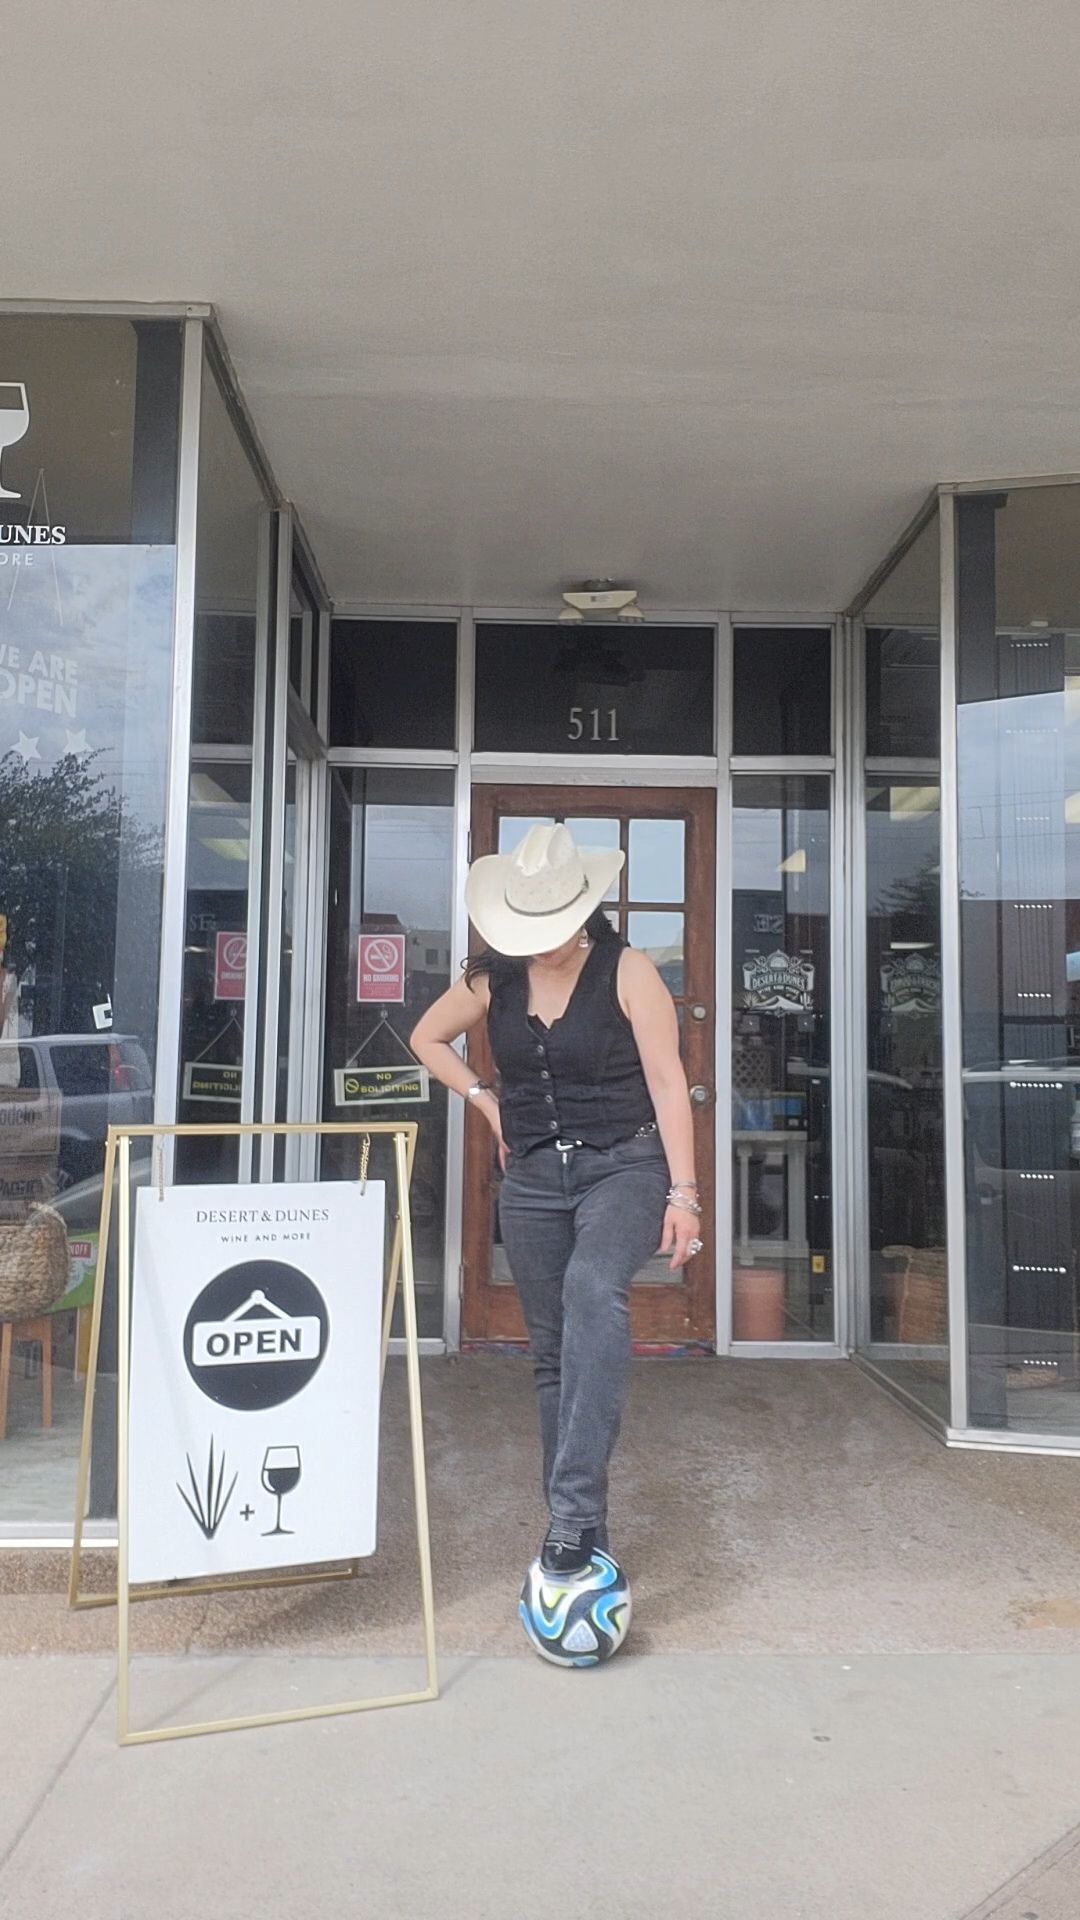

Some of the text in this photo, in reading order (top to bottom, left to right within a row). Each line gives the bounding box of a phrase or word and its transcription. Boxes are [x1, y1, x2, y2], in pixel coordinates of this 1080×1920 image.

[0, 524, 66, 544] UNES
[28, 650, 78, 685] ARE
[567, 707, 619, 741] 511
[360, 1083, 418, 1094] SOLICITING
[196, 1209, 259, 1224] DESERT
[275, 1208, 329, 1222] DUNES
[221, 1232, 311, 1243] WINE AND MORE
[206, 1328, 302, 1357] OPEN
